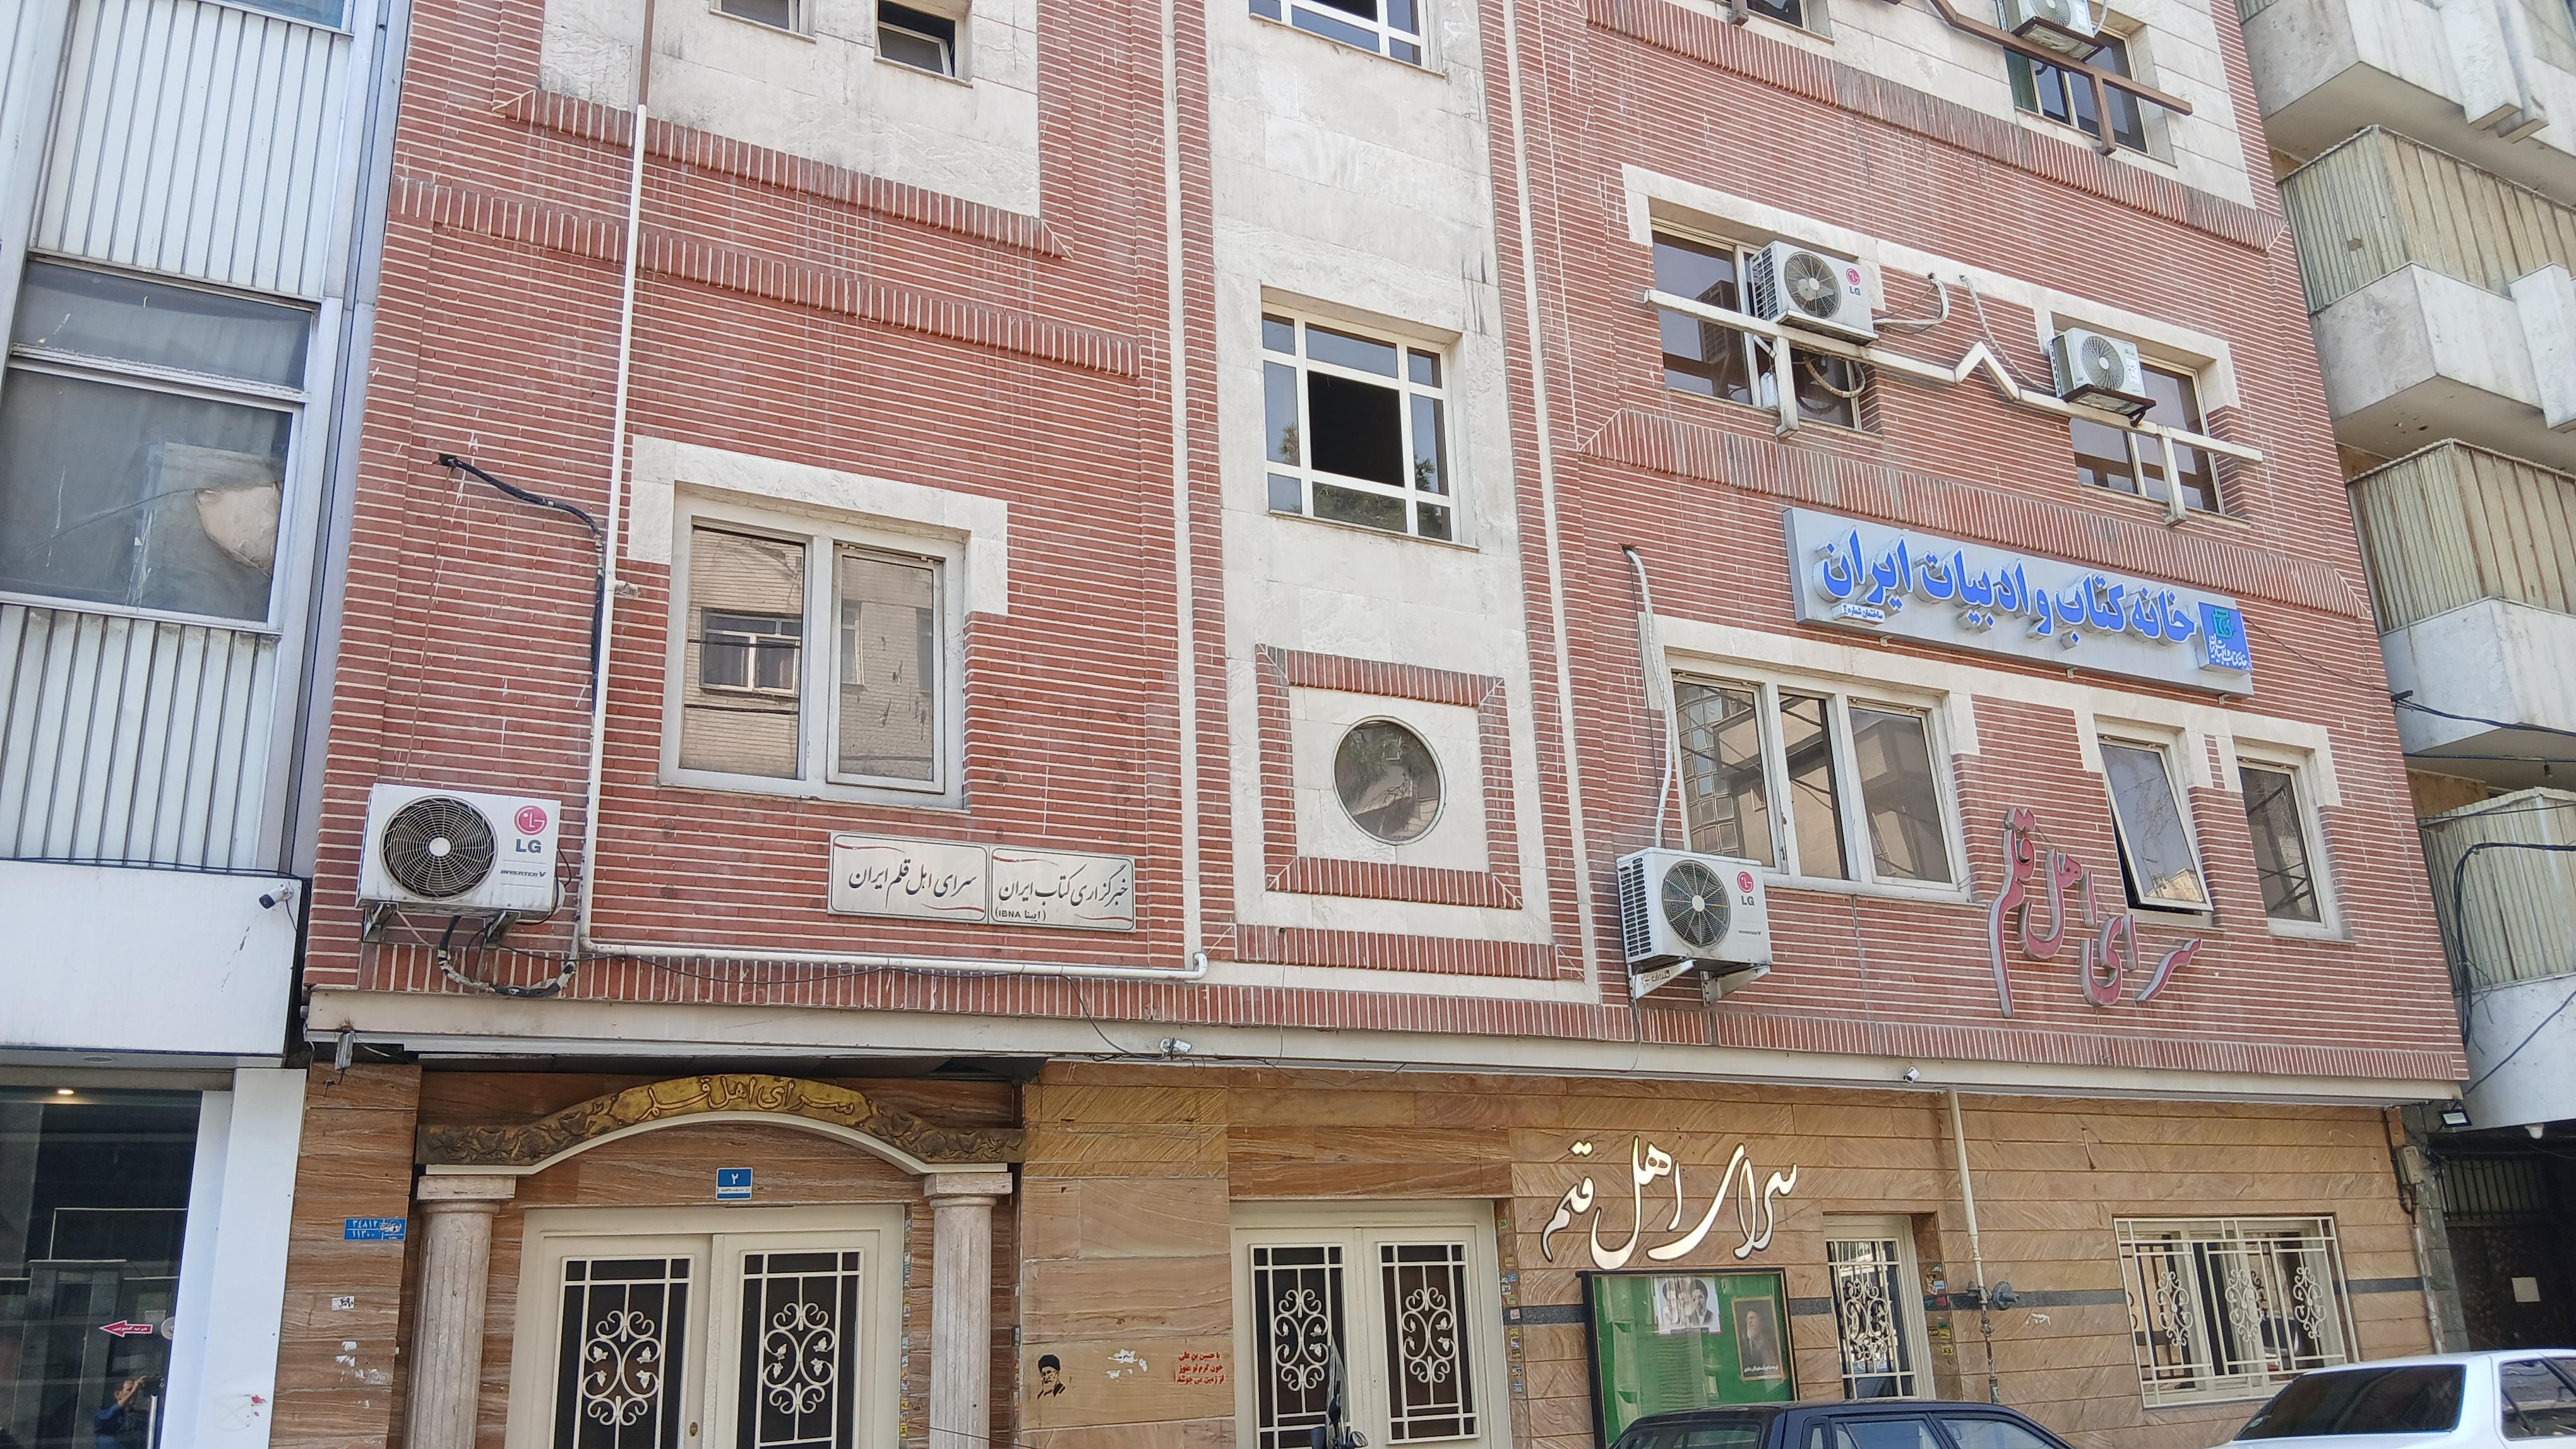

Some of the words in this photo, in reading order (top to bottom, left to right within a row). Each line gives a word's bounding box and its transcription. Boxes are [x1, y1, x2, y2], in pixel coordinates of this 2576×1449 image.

[1849, 286, 1860, 296] LG
[1822, 525, 1913, 612] ایران
[1920, 546, 2031, 627] ادبیات
[1848, 606, 1862, 616] شماره
[1863, 609, 1883, 619] ساختمان
[2032, 586, 2052, 638] و
[2055, 573, 2126, 647] کتاب
[2130, 583, 2198, 644] خانه
[515, 838, 542, 853] LG
[849, 864, 888, 890] ایران
[885, 859, 911, 909] قلم
[905, 864, 932, 895] اهل
[933, 874, 977, 898] سرای
[998, 879, 1034, 902] ایران
[1035, 864, 1087, 907] کتاب
[1071, 864, 1129, 907] خبرگزاری
[1741, 895, 1755, 907] LG
[1988, 807, 2037, 1018] قلم
[2020, 848, 2097, 960] اهل
[2080, 914, 2202, 1008] سرای
[635, 1075, 712, 1121] قلم
[707, 1075, 756, 1110] اهل
[758, 1076, 856, 1112] سرای
[731, 1172, 739, 1185] ۲
[1540, 1140, 1595, 1263] قلم
[1588, 1135, 1683, 1270] اهل
[1178, 1351, 1190, 1361] علی
[1191, 1353, 1198, 1361] بن
[1199, 1353, 1215, 1361] حسین
[1210, 1363, 1224, 1373] خون
[1216, 1351, 1220, 1361] یا
[1203, 1375, 1218, 1384] زمین
